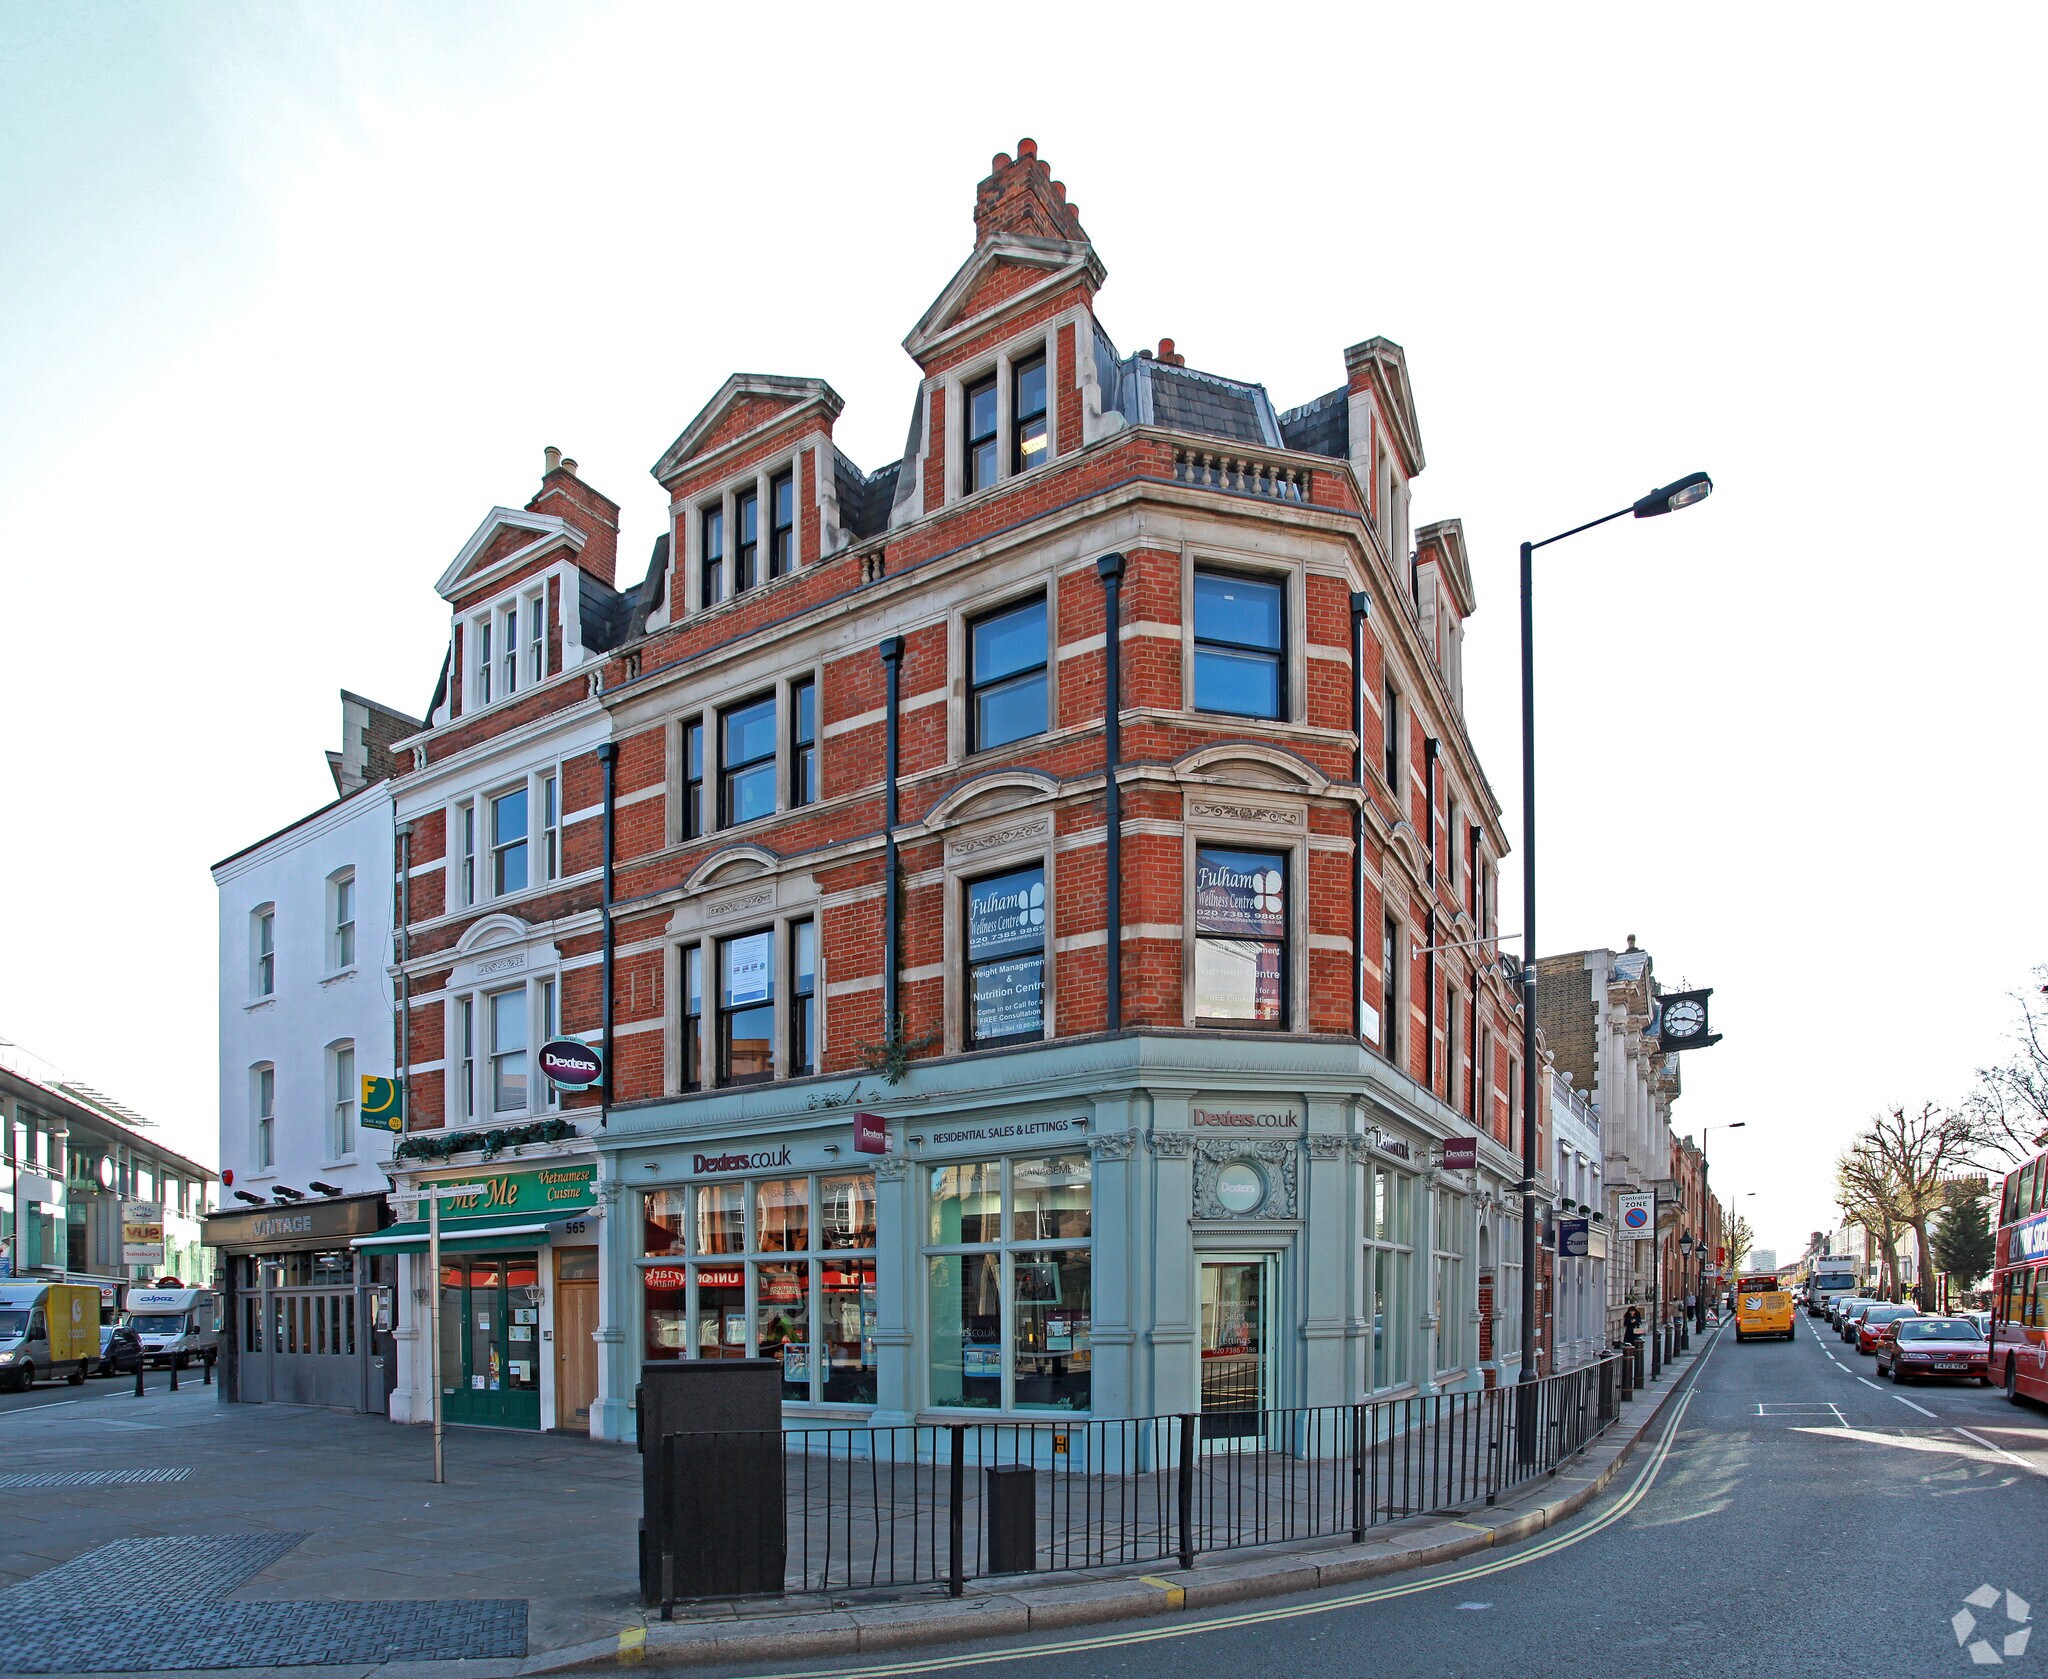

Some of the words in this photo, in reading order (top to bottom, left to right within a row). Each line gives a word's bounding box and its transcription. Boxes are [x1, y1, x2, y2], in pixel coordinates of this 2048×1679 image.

[1196, 866, 1253, 889] Fulham
[970, 891, 1019, 921] Fulham
[1197, 889, 1228, 908] Wellness
[1230, 893, 1254, 909] Centre
[1221, 910, 1251, 918] 7385
[1254, 912, 1282, 920] 9869
[971, 917, 997, 936] Wellness
[997, 915, 1020, 931] Centre
[969, 936, 988, 945] 020
[991, 930, 1017, 941] 7385
[971, 967, 998, 979] Weight
[999, 959, 1045, 973] Managemen
[1006, 974, 1013, 983] &
[973, 987, 1013, 1002] Nutrition
[978, 1007, 996, 1016] Come
[1013, 1000, 1027, 1010] Call
[1027, 1000, 1037, 1008] for
[979, 1015, 998, 1025] FREE
[999, 1008, 1041, 1021] Consultation
[545, 1053, 597, 1071] Dexters
[1193, 1108, 1298, 1128] Dexters.co.uk
[862, 1127, 884, 1140] Dexters
[933, 1128, 987, 1144] RESIDENTIAL
[988, 1126, 1015, 1139] SALES
[1016, 1125, 1024, 1135] &
[1025, 1120, 1069, 1135] LETTINGS
[693, 1144, 792, 1175] Dexters.co.uk
[1445, 1149, 1474, 1159] Dexters
[538, 1169, 590, 1185] Vietnamese
[944, 1171, 987, 1184] LETTINGS
[1018, 1163, 1085, 1179] MANAGEMENT
[547, 1185, 581, 1202] Cuisine
[772, 1187, 795, 1198] SALES
[825, 1181, 875, 1194] MORTGAGES
[1221, 1181, 1256, 1193] Dexters
[1620, 1194, 1652, 1202] Controlled
[126, 1226, 160, 1240] vue
[252, 1215, 312, 1237] VINTAGE
[566, 1221, 586, 1234] 565
[125, 1251, 161, 1259] Sainsbury's
[1224, 1311, 1246, 1320] Sales
